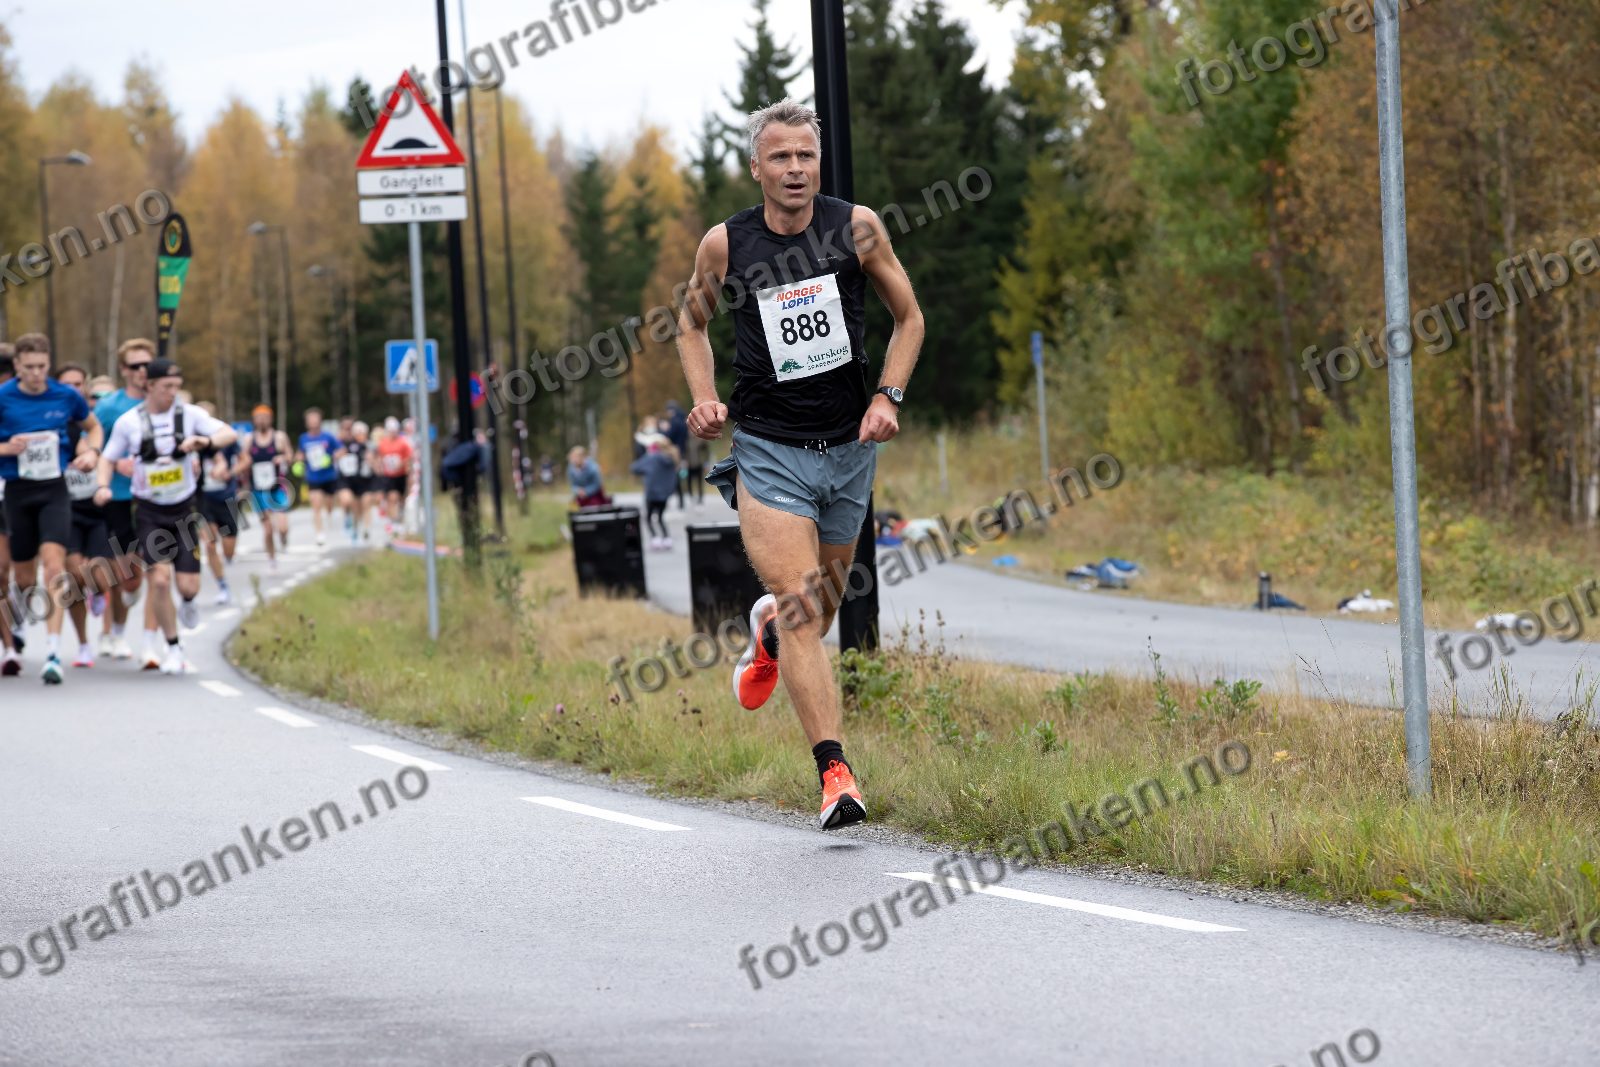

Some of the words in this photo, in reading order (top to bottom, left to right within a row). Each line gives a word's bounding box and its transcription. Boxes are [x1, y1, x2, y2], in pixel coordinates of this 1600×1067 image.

[776, 284, 823, 302] NORGES
[781, 294, 816, 310] LØPET
[780, 309, 831, 345] 888
[806, 345, 849, 364] Aurskog
